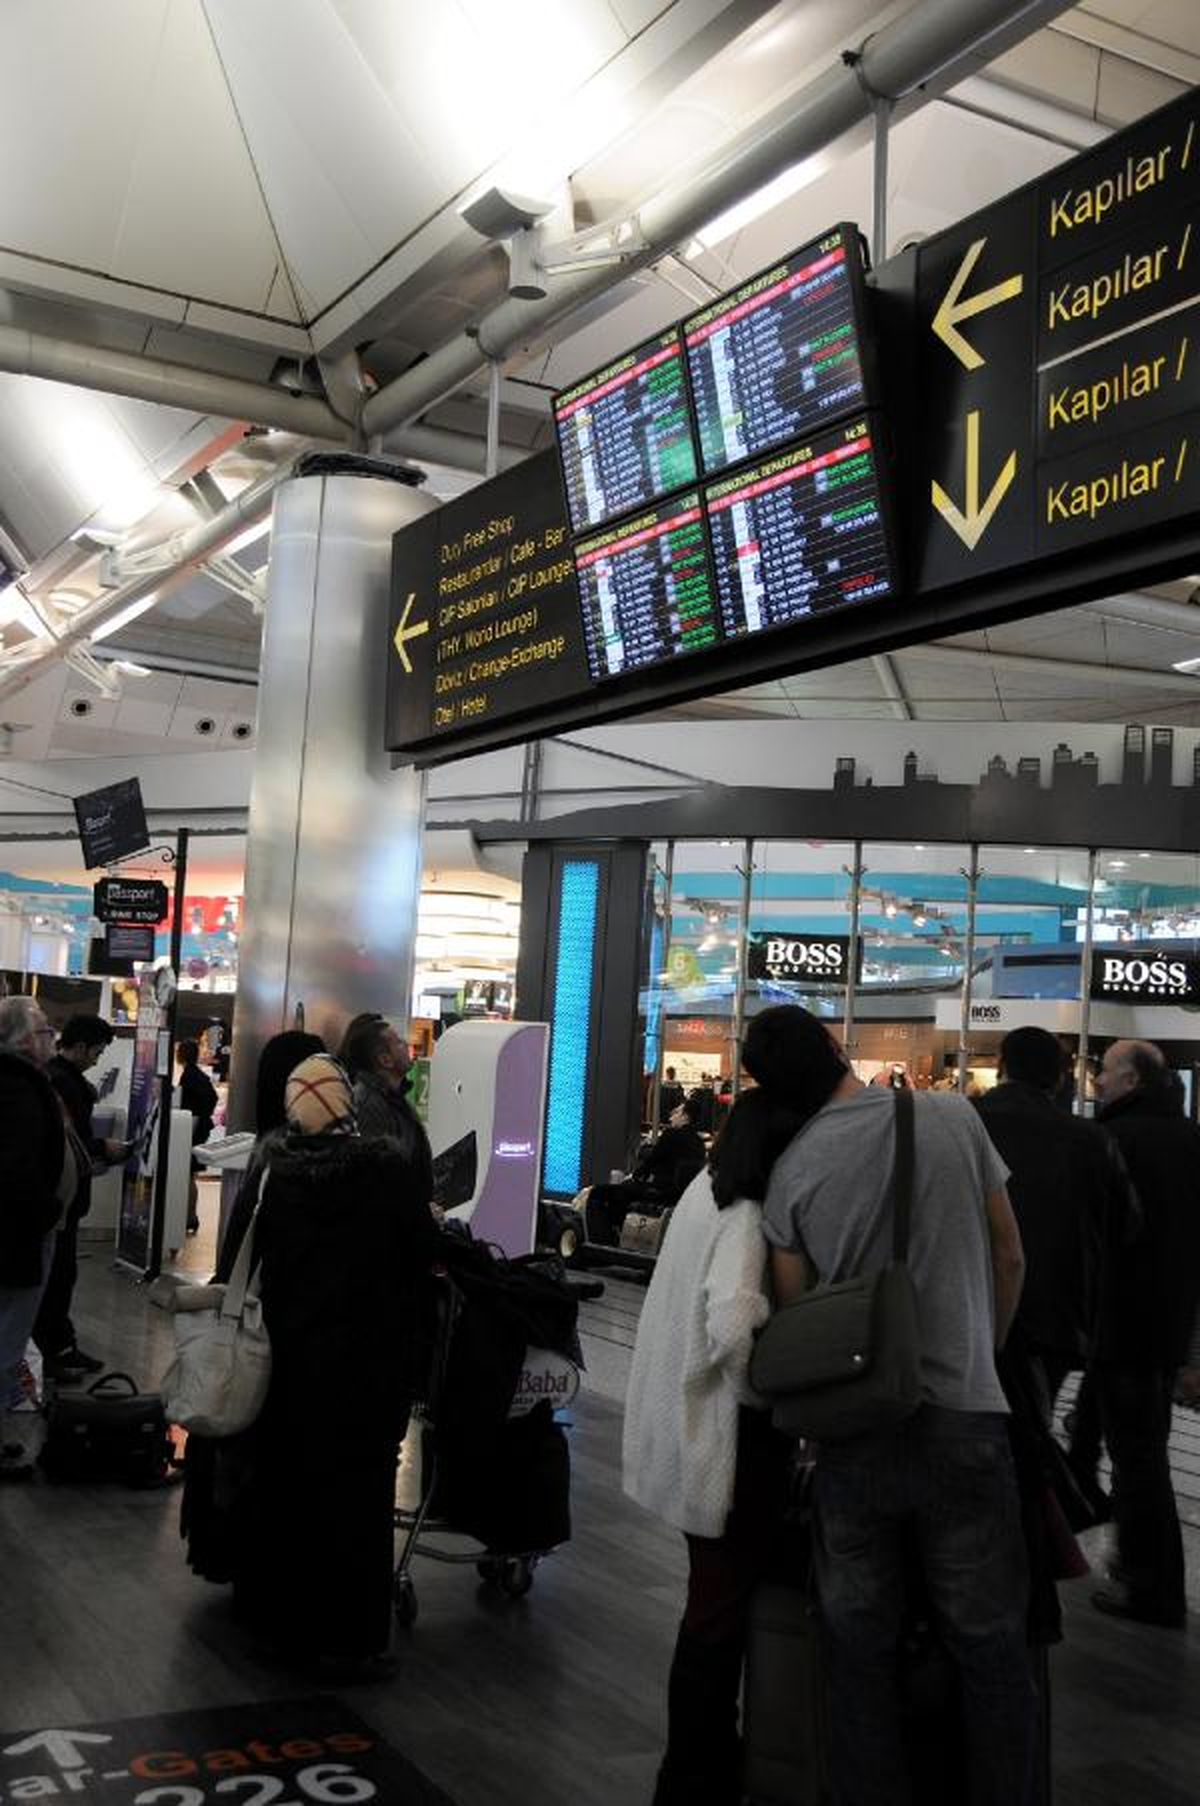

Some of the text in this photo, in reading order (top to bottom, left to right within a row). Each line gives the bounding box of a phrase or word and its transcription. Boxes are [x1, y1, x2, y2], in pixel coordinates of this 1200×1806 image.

[1050, 121, 1195, 237] Kapılar /
[1048, 224, 1191, 330] Kapılar /
[1048, 337, 1188, 430] Kapılar /
[1046, 440, 1187, 524] Kapılar /
[463, 530, 487, 553] Free
[487, 515, 515, 541] Shop
[766, 941, 843, 967] BOSS
[1103, 958, 1187, 987] BOSS
[971, 1005, 1001, 1018] BOSS
